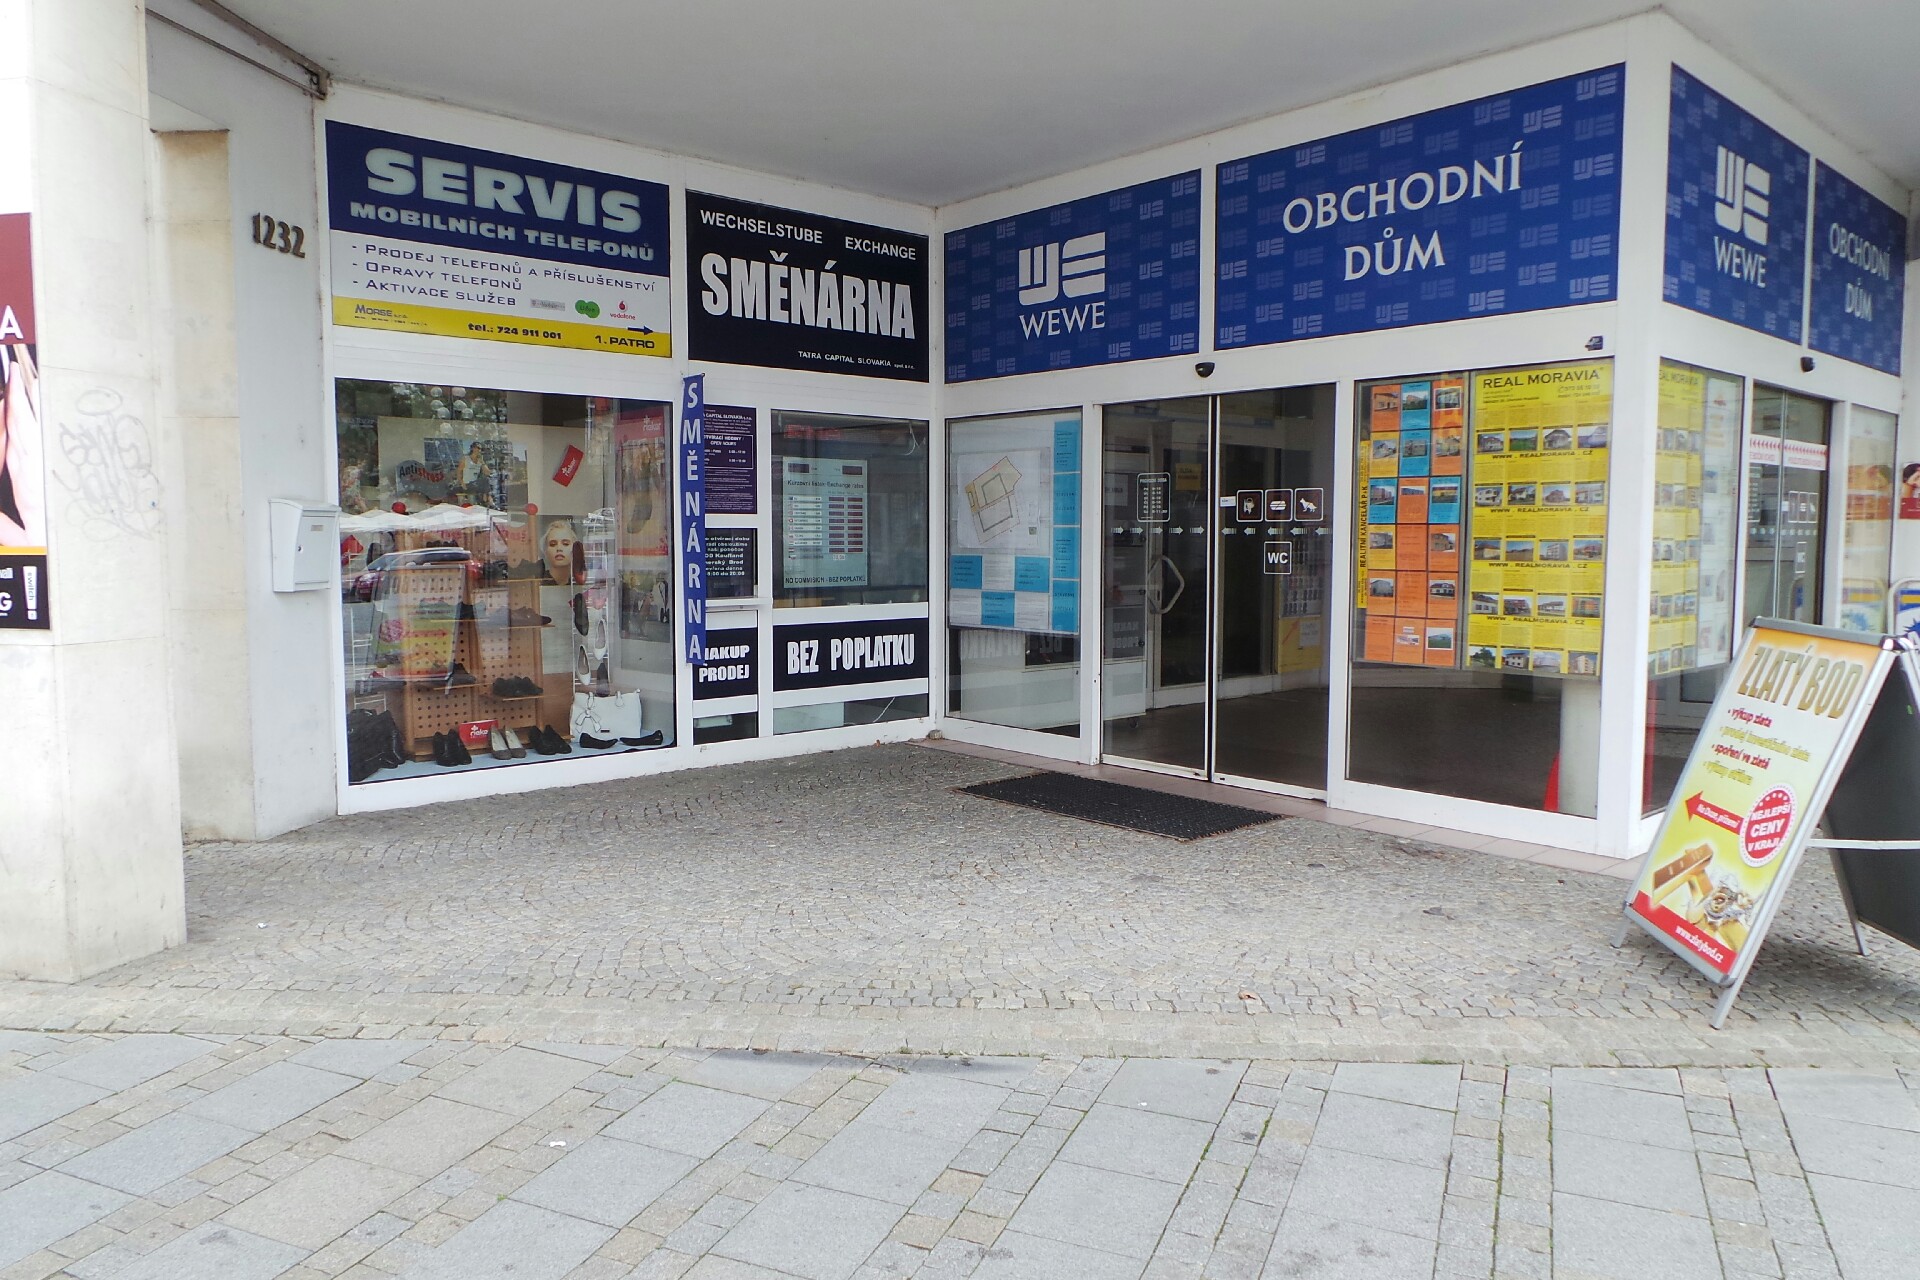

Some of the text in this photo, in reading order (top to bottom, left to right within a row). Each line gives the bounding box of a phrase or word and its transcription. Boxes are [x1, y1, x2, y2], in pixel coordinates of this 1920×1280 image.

[365, 147, 642, 234] SERVIS
[1282, 140, 1524, 234] OBCHODNÍ
[251, 212, 306, 259] 1232
[350, 201, 655, 262] MOBILNÍCH TELEFONŮ
[700, 209, 916, 260] WECHSELSTUBE EXCHANGE
[365, 244, 656, 293] PRODEJ TELEFONŮ A PŘÍSLUŠENSTVÍ
[1343, 227, 1445, 281] DŮM
[1714, 235, 1766, 289] WEWE
[1829, 222, 1891, 281] OBCHODNÍ
[365, 262, 522, 291] OPRAVY TELEFONŮ
[365, 279, 449, 300] AKTIVACE
[455, 290, 517, 306] SLUŽEB
[700, 249, 916, 340] SMĚNÁRNA
[355, 304, 393, 317] MORSE
[610, 312, 636, 321] vodafone
[1845, 277, 1873, 322] DŮM
[468, 322, 562, 340] tel.: 724 911 001
[1018, 301, 1106, 341] WEWE
[595, 335, 655, 349] 1. PATRO
[798, 350, 821, 361] TATRA
[825, 353, 855, 364] CAPITAL
[857, 357, 891, 367] SLOVAKIA
[1483, 368, 1600, 389] REAL MORAVIA
[1358, 500, 1368, 537] KANCELÁŘ
[1267, 552, 1289, 565] WC
[1358, 538, 1367, 568] REALITNÍ
[786, 632, 916, 675] BEZ POPLATKU
[699, 664, 750, 683] PRODEJ
[1737, 645, 1864, 720] ZLATÝ BOD
[1750, 802, 1791, 821] NEJLEPŠÍ
[1750, 818, 1785, 838] CENY
[1747, 842, 1756, 852] V
